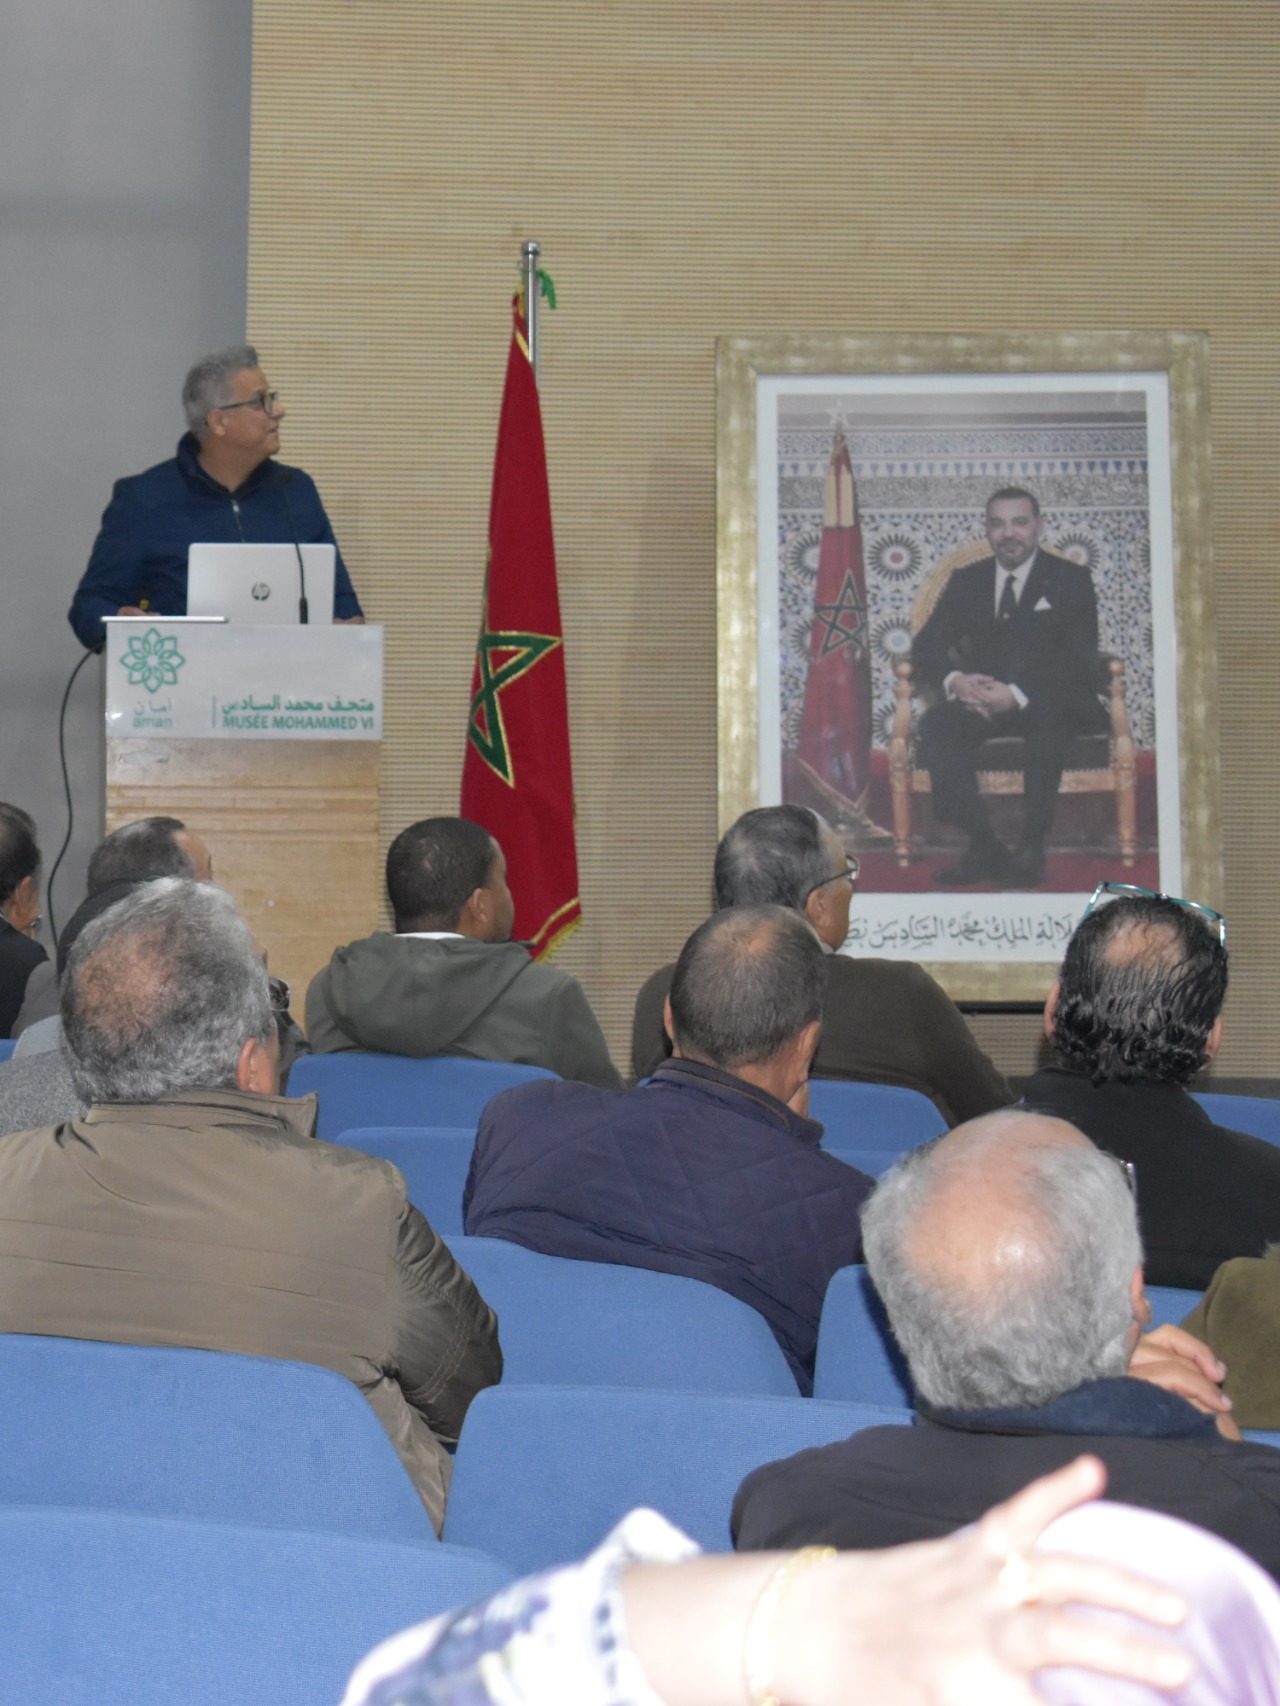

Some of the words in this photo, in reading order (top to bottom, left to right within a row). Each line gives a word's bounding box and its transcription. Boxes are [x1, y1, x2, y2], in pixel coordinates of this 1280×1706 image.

[221, 695, 280, 714] السادس
[284, 698, 323, 711] محمد
[328, 696, 375, 712] متحف
[132, 717, 173, 729] aman
[222, 713, 269, 729] MUSÉE
[271, 715, 358, 730] MOHAMMED
[361, 716, 374, 730] VI
[1036, 913, 1073, 947] لالة
